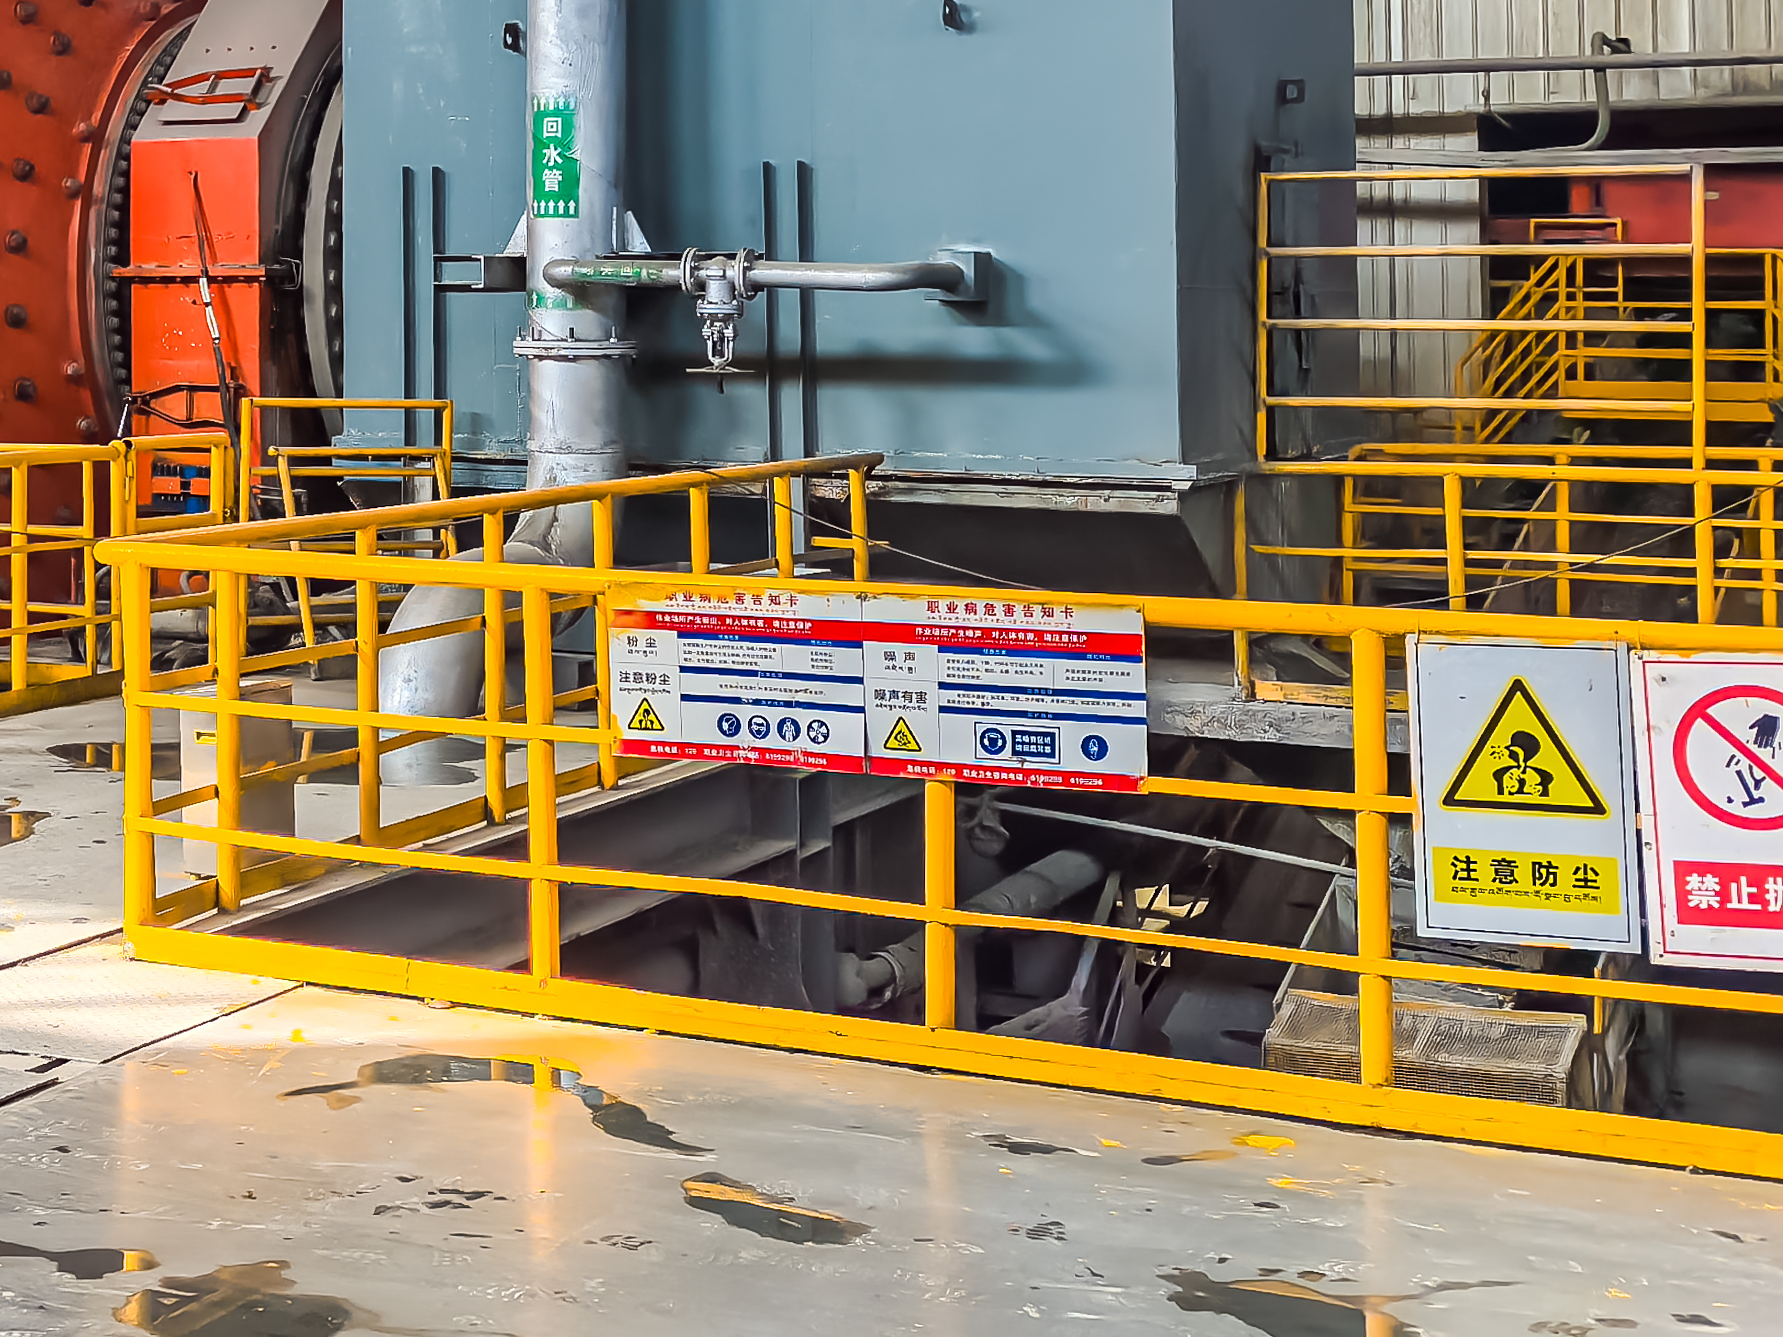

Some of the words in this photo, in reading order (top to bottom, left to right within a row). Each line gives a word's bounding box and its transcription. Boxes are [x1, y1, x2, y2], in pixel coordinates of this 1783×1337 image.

[542, 117, 563, 192] 回水管
[926, 600, 1074, 619] 职业病危害告知卡
[627, 635, 657, 648] 粉尘
[619, 670, 671, 686] 注意粉尘
[874, 689, 928, 705] 噪声有害
[1450, 855, 1601, 890] 注意防尘
